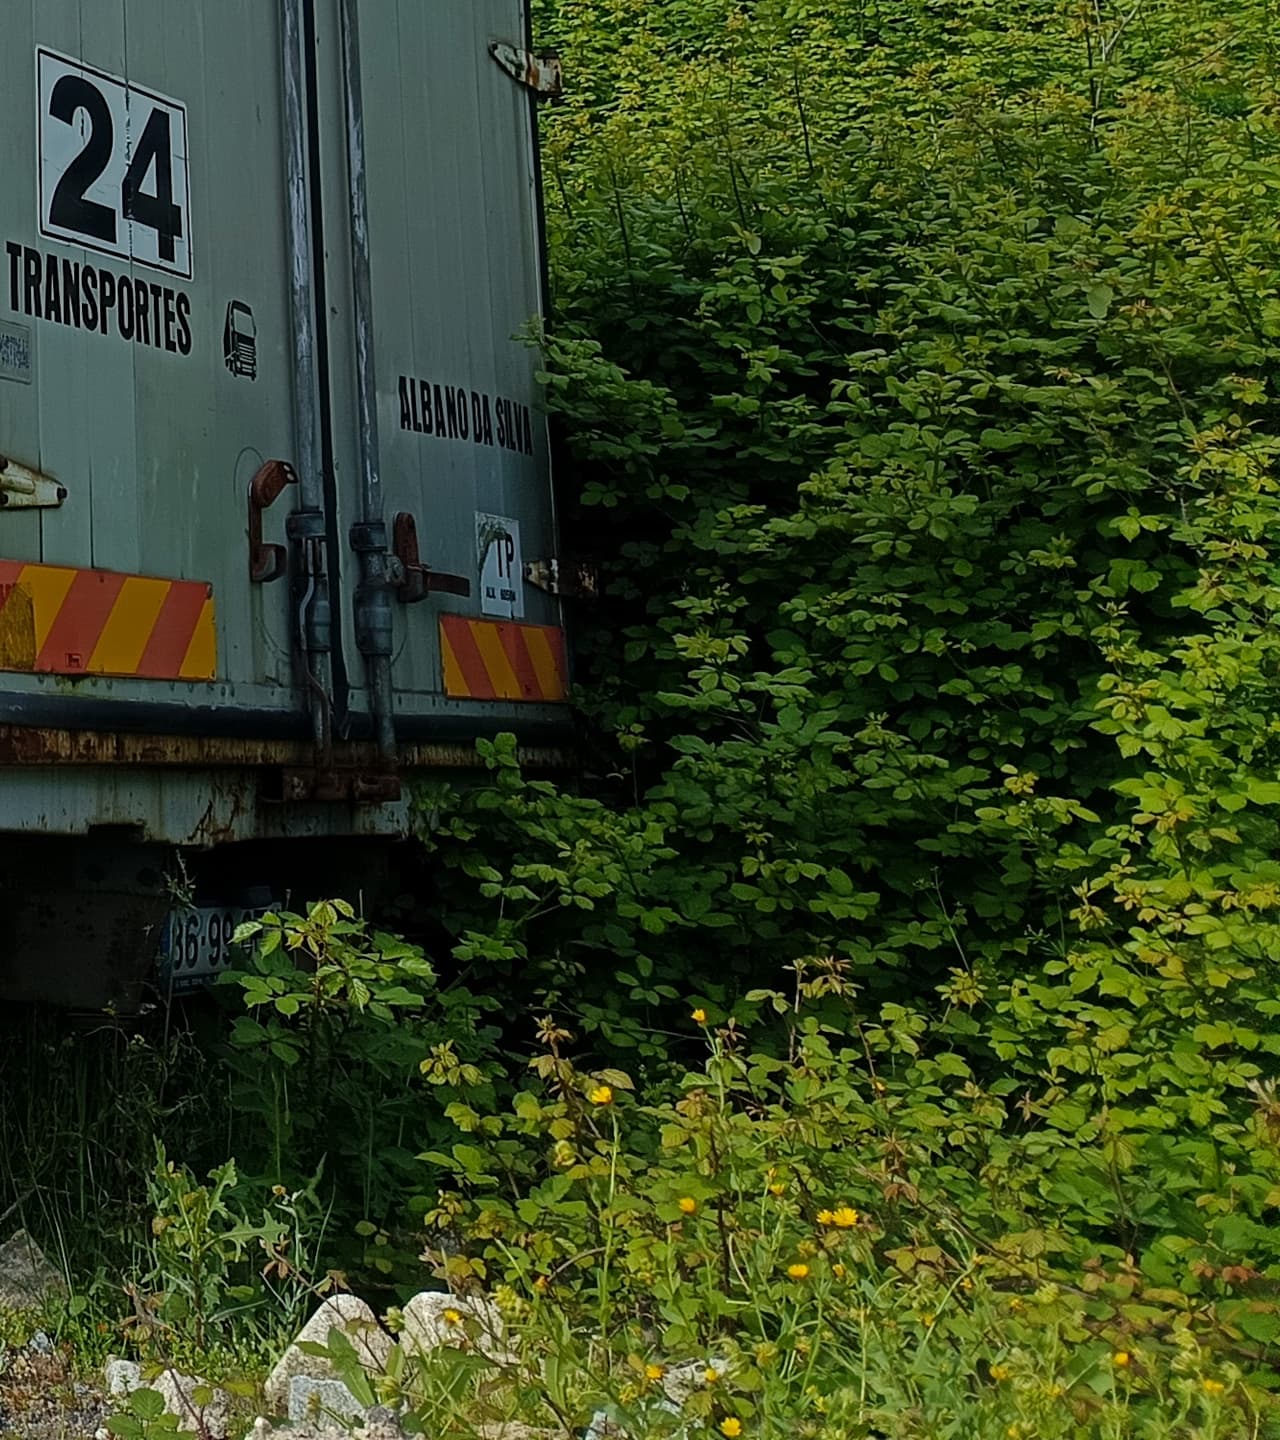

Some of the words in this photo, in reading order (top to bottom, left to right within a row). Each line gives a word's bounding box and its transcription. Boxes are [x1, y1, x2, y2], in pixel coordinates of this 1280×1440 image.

[48, 74, 184, 264] 24
[5, 240, 192, 357] TRANSPORTES
[398, 375, 469, 442] ALBANO
[471, 390, 493, 448] DA
[495, 396, 533, 457] SILVA
